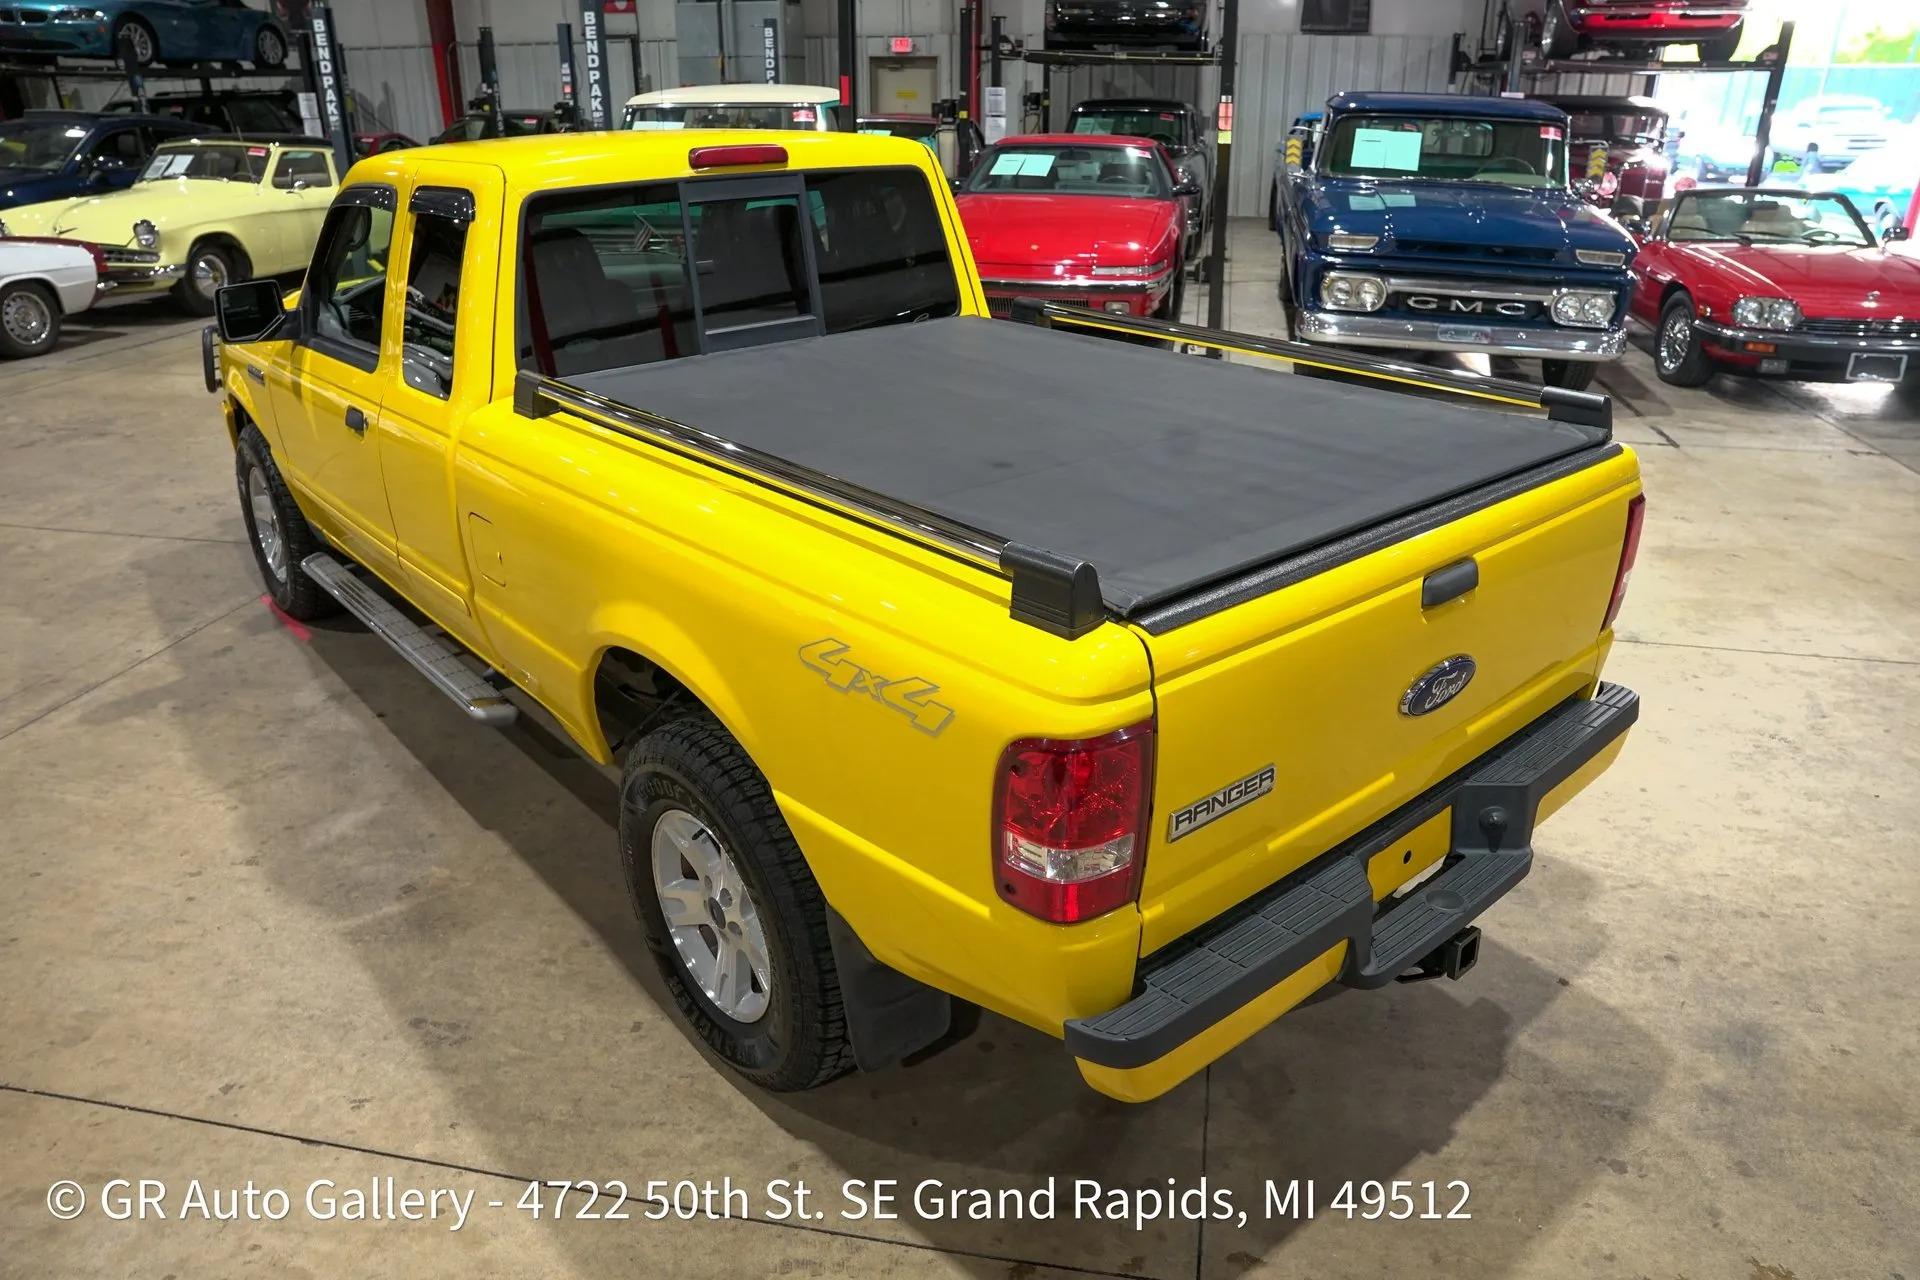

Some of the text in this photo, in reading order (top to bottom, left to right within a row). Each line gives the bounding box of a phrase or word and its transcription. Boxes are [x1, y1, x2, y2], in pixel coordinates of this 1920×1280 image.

[312, 19, 339, 115] BENDPAK
[584, 11, 603, 111] BENDPAK
[1406, 296, 1526, 315] GMC
[798, 638, 955, 736] 4x4
[1424, 670, 1467, 710] Ford
[1174, 767, 1275, 832] RANGER
